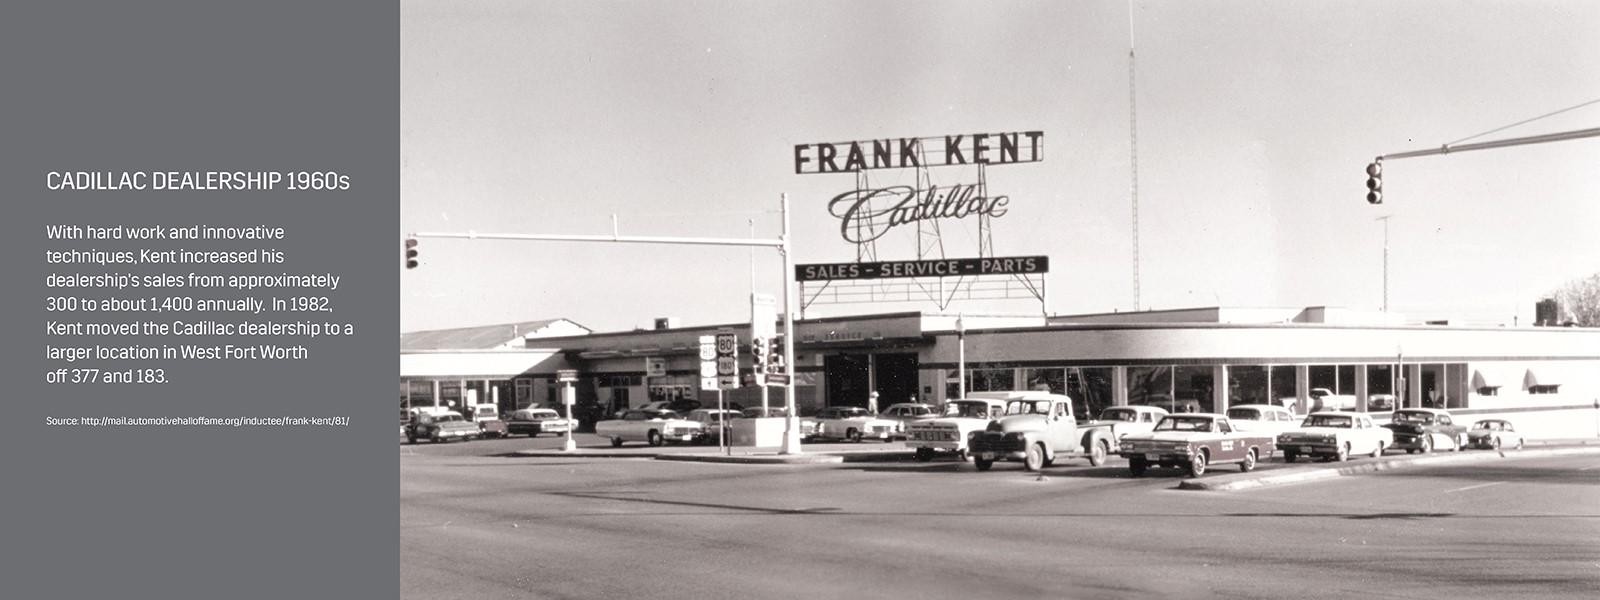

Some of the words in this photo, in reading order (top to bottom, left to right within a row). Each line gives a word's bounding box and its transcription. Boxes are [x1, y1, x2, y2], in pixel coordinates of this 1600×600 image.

[795, 137, 920, 174] FRANK
[945, 131, 1044, 165] KENT
[828, 184, 1008, 244] Cadillac
[805, 264, 860, 279] SALES
[880, 261, 959, 277] SERVICE
[981, 258, 1036, 273] PARTS
[720, 340, 731, 350] 80
